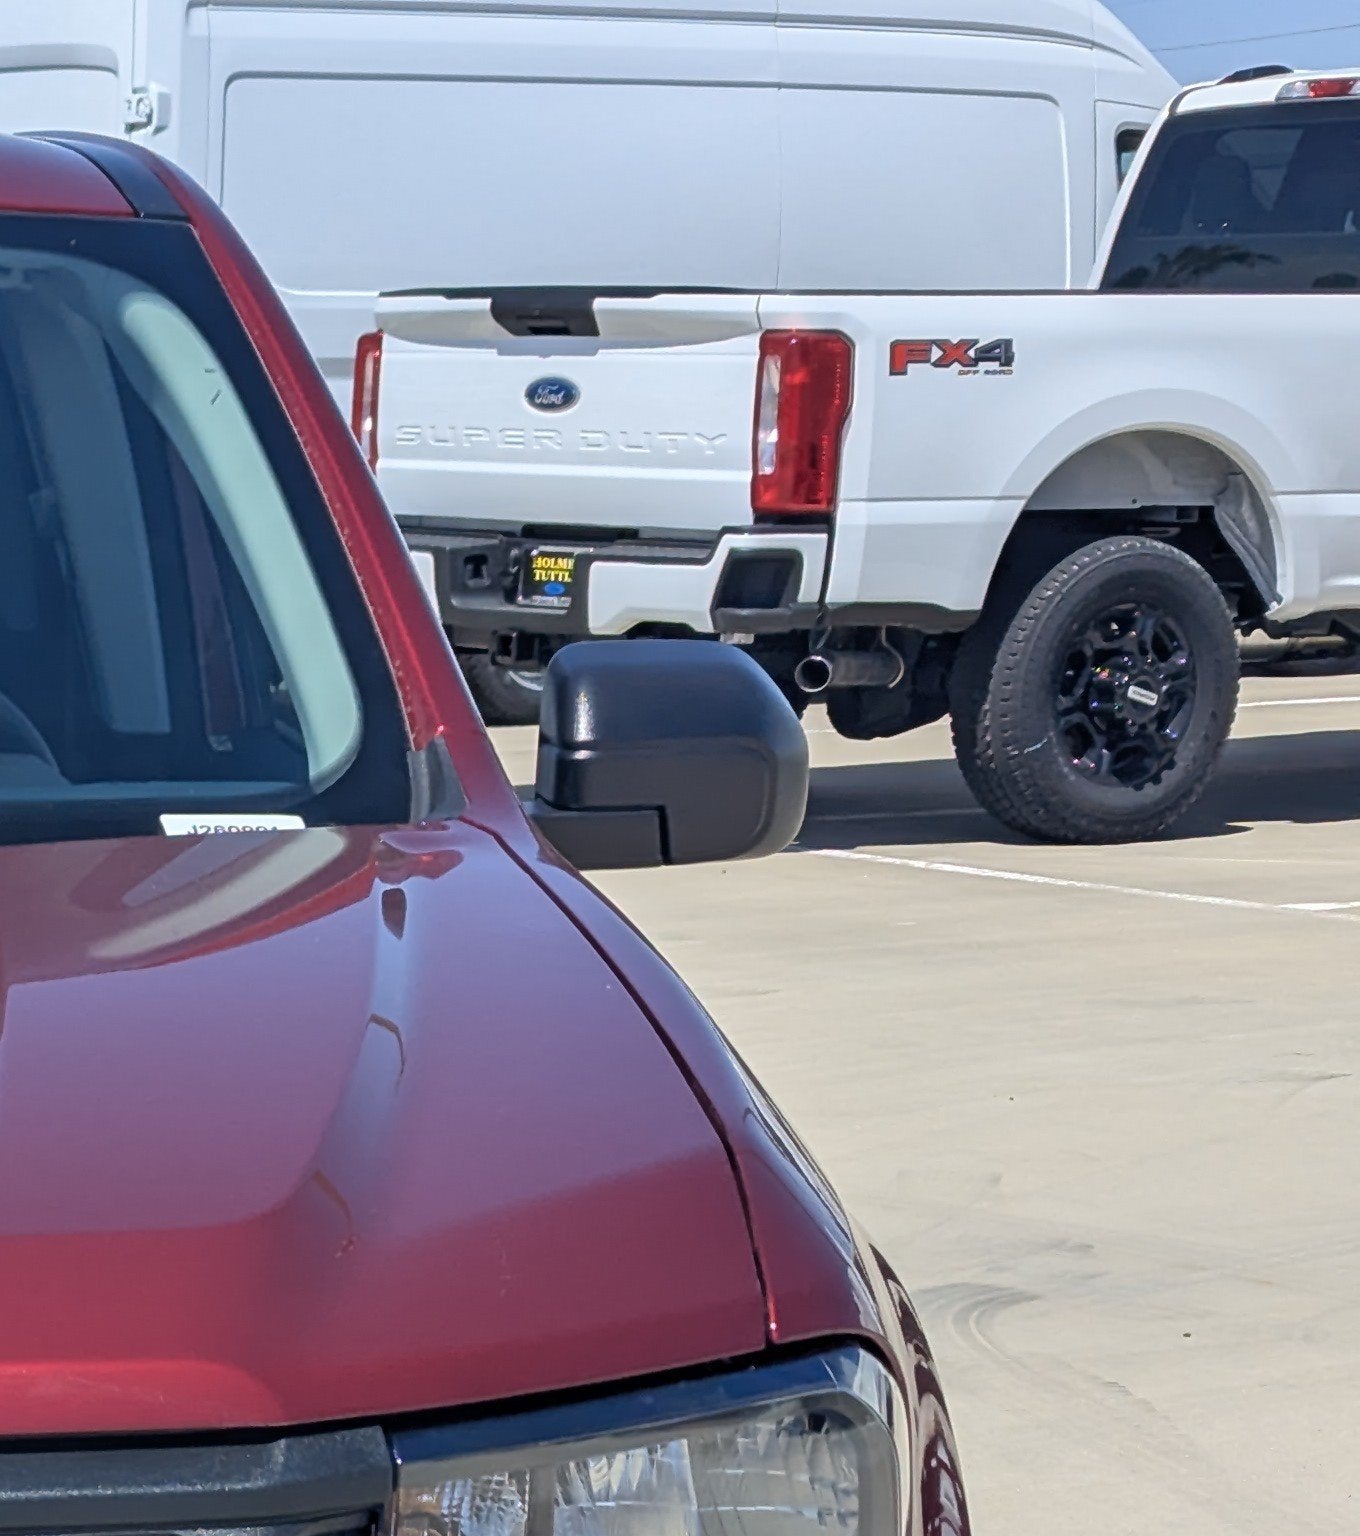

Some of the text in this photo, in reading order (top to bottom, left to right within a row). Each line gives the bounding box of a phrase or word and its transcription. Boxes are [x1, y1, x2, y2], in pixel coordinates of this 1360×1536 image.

[888, 338, 1016, 376] FX4
[534, 384, 565, 405] Ford
[395, 424, 728, 455] SUPER DUTY
[533, 569, 574, 583] TUTTL
